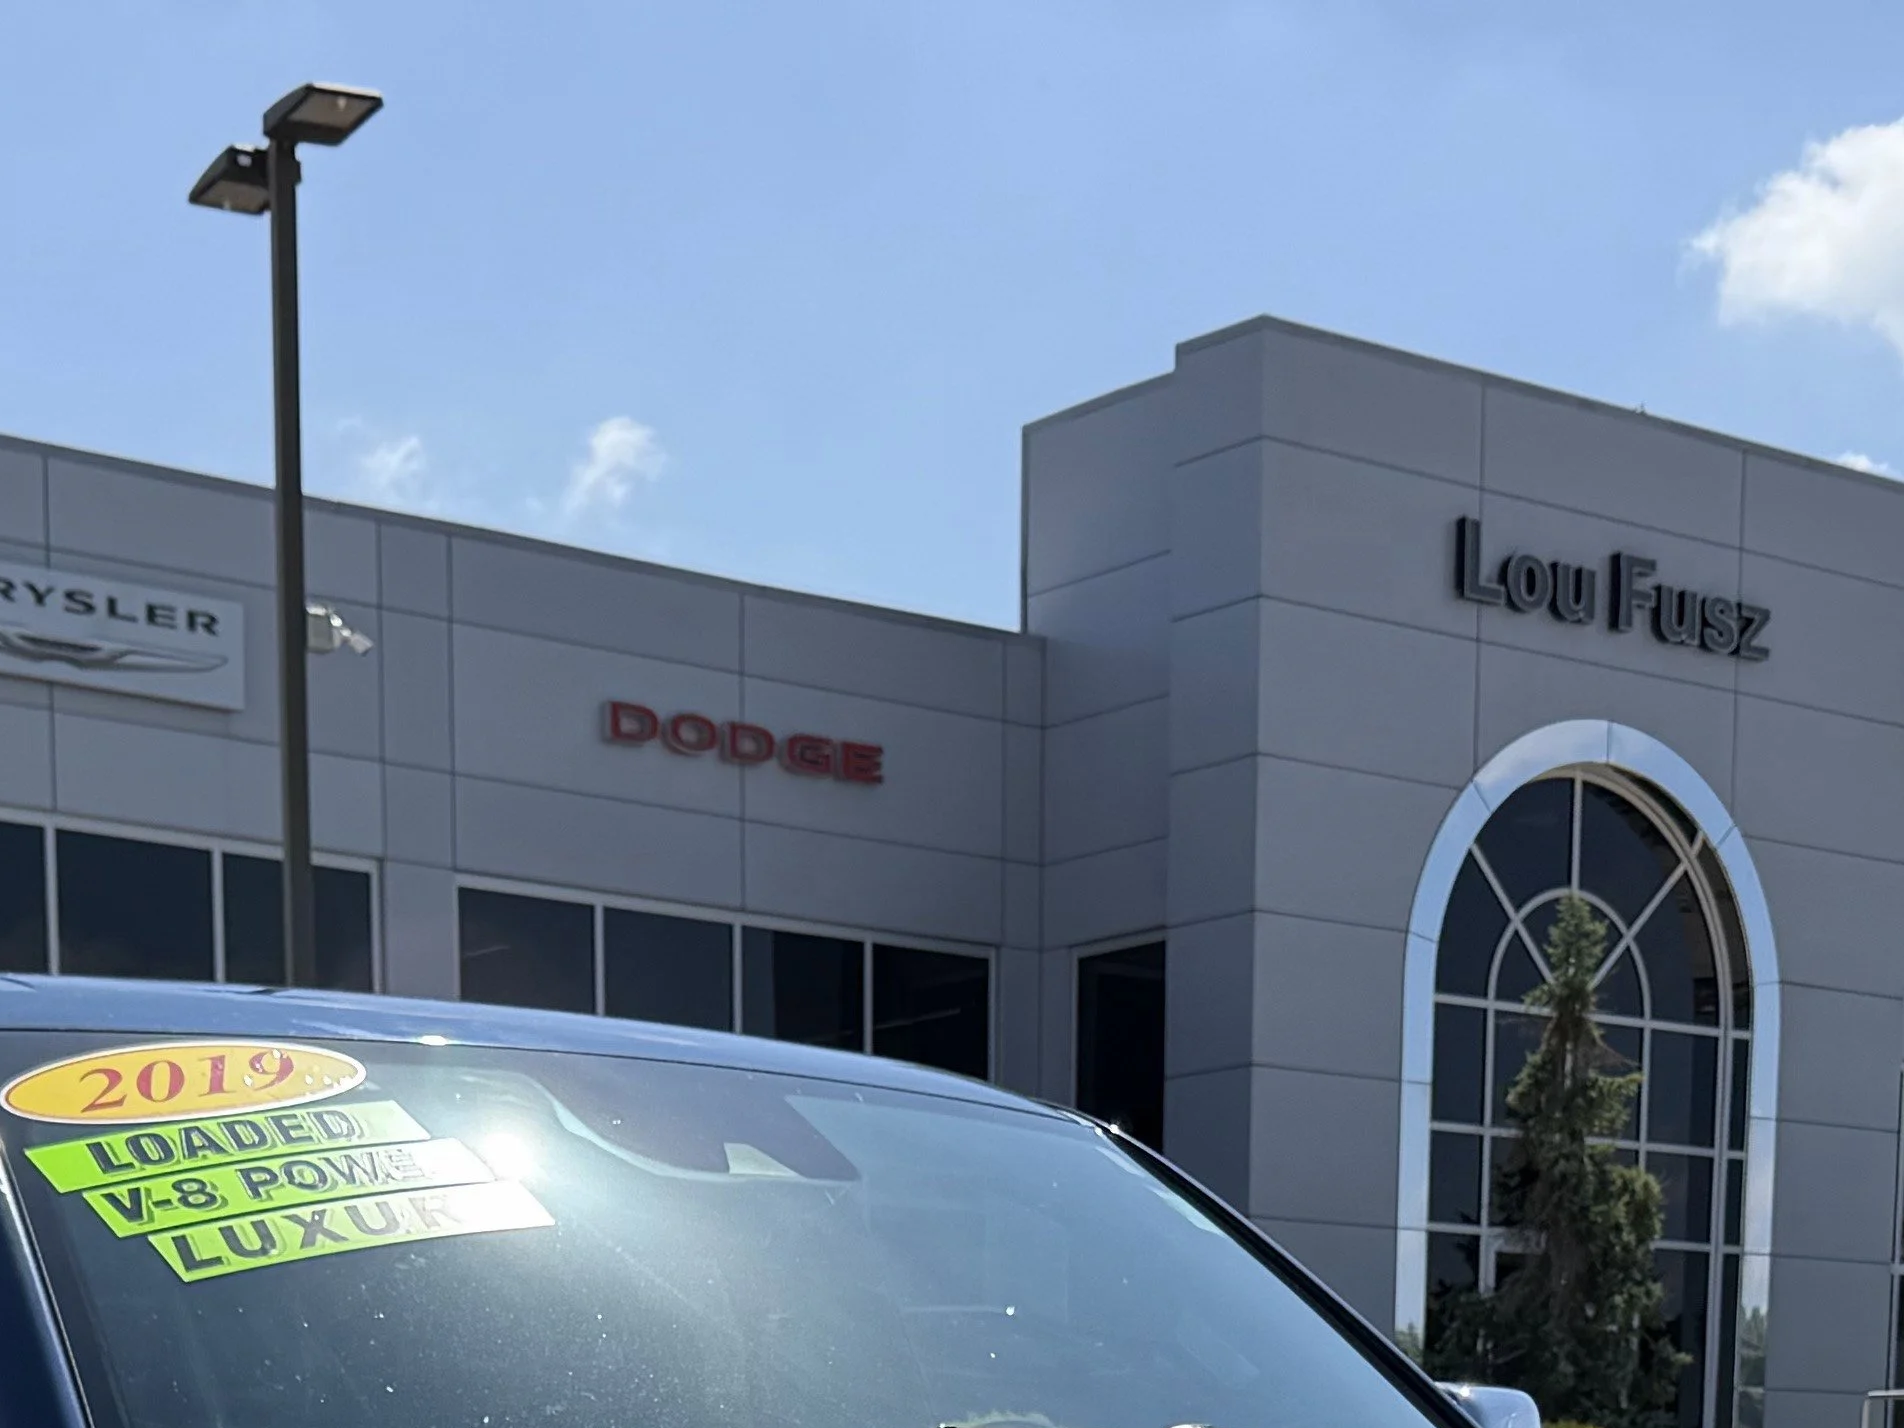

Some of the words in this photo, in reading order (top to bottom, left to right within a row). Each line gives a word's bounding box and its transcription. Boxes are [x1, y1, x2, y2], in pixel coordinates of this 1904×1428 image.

[1454, 515, 1597, 624] Lou
[1607, 551, 1772, 662] Fusz
[601, 699, 886, 784] DODGE
[79, 1050, 296, 1114] 2019
[84, 1108, 364, 1175] LOADED
[100, 1177, 226, 1223] V-8
[235, 1147, 431, 1201] POWE
